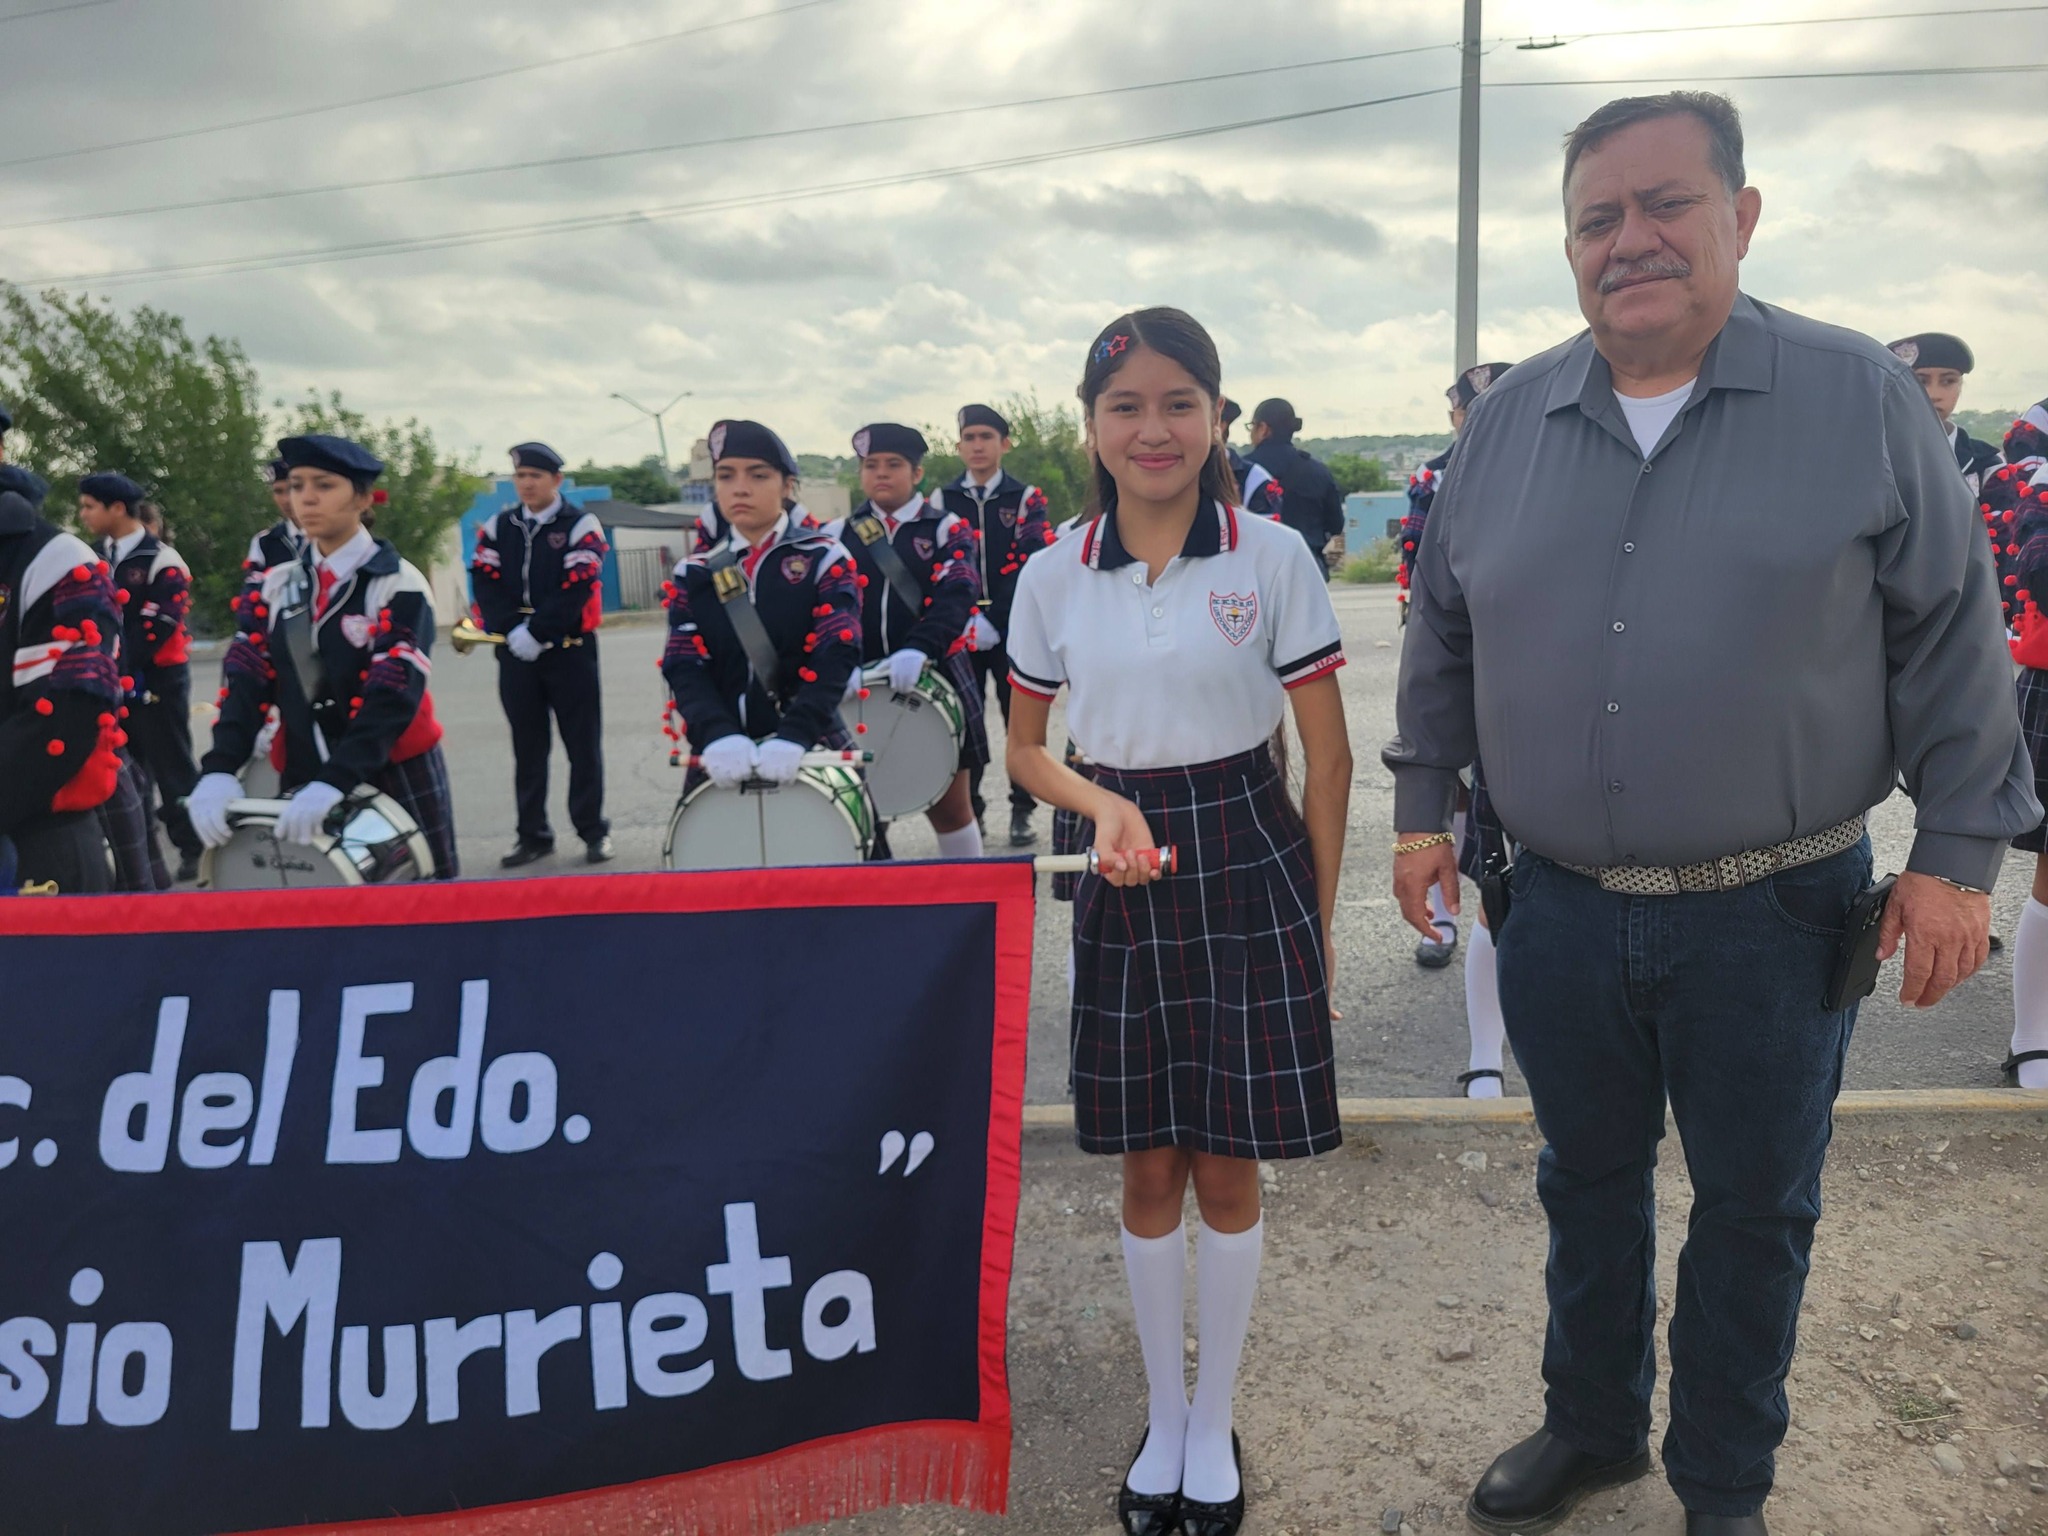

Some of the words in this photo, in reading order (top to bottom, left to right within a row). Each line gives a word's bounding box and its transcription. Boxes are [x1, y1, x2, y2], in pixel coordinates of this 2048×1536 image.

[98, 989, 301, 1173] del
[326, 979, 591, 1164] Edo.
[0, 1266, 174, 1428] sio
